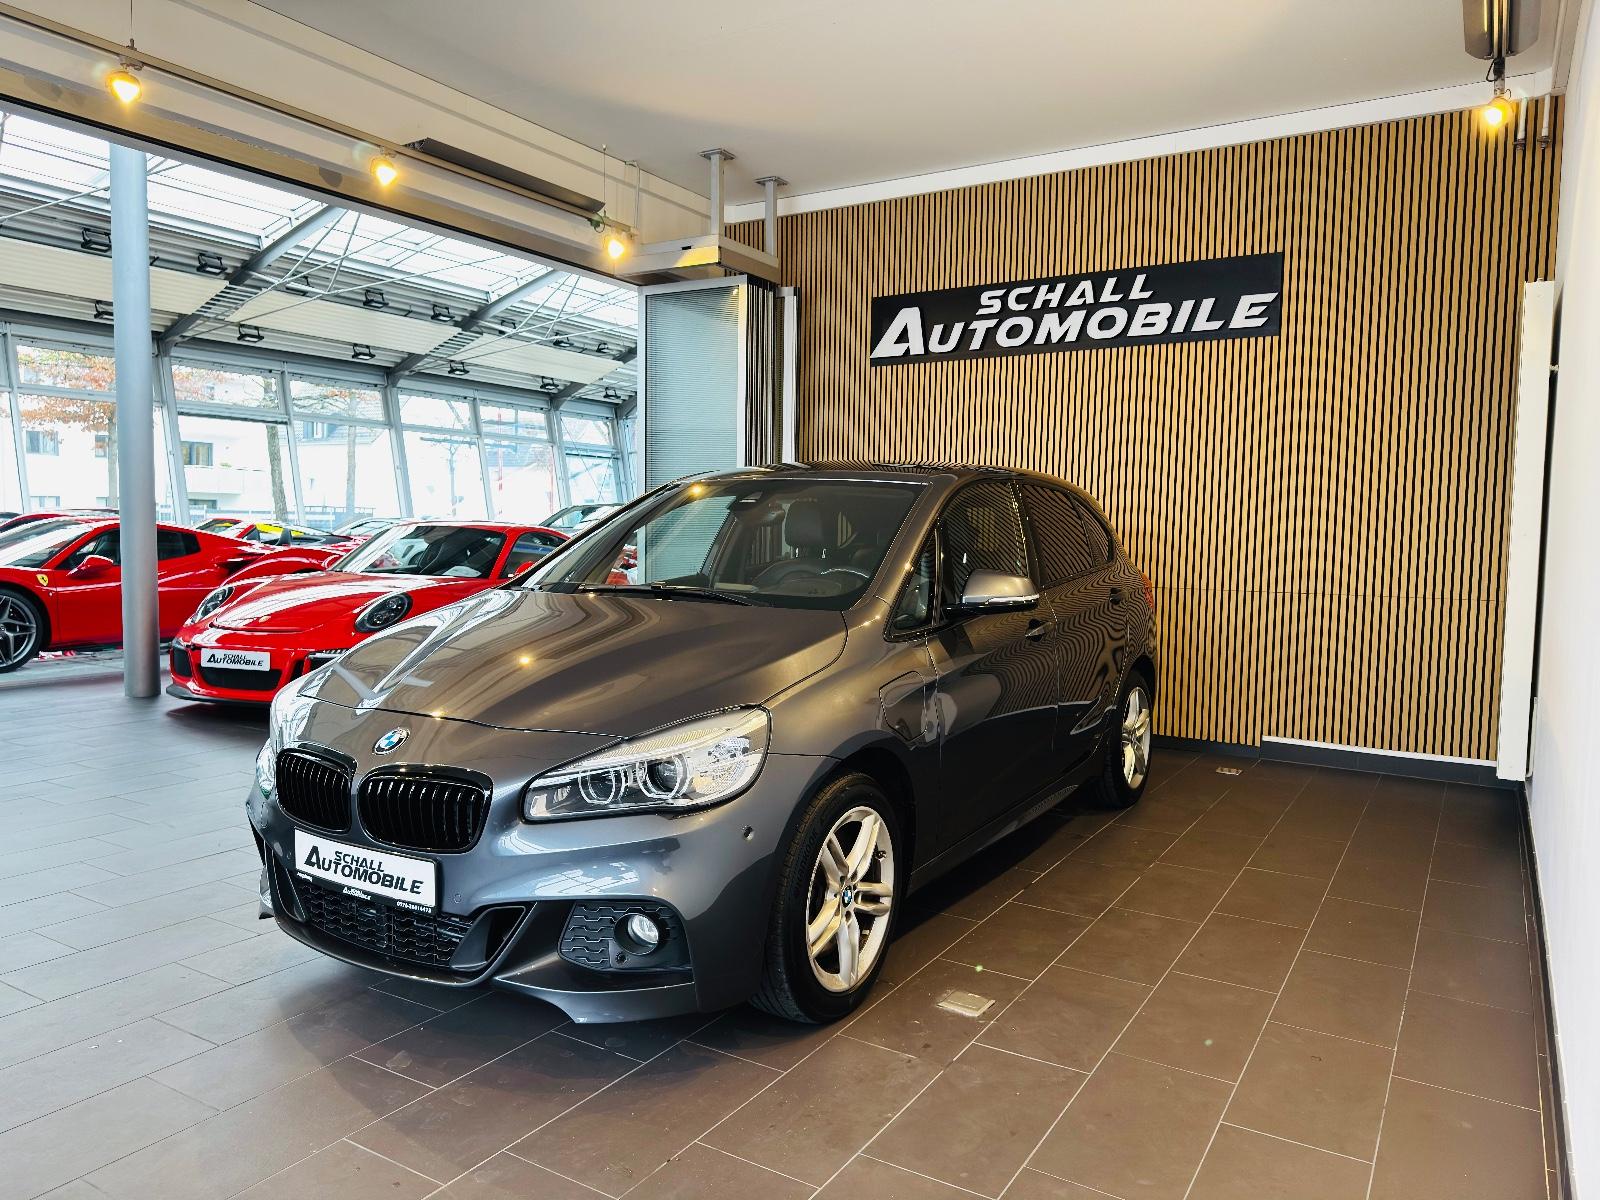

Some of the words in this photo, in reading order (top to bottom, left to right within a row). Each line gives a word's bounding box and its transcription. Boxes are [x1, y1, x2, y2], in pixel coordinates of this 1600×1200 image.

[975, 273, 1154, 316] SCHALL
[869, 291, 1279, 359] AUTOMOBILE
[206, 653, 264, 667] AUTOMOBILE
[303, 845, 425, 895] AUTOMOBILE
[334, 850, 385, 873] SCHALL
